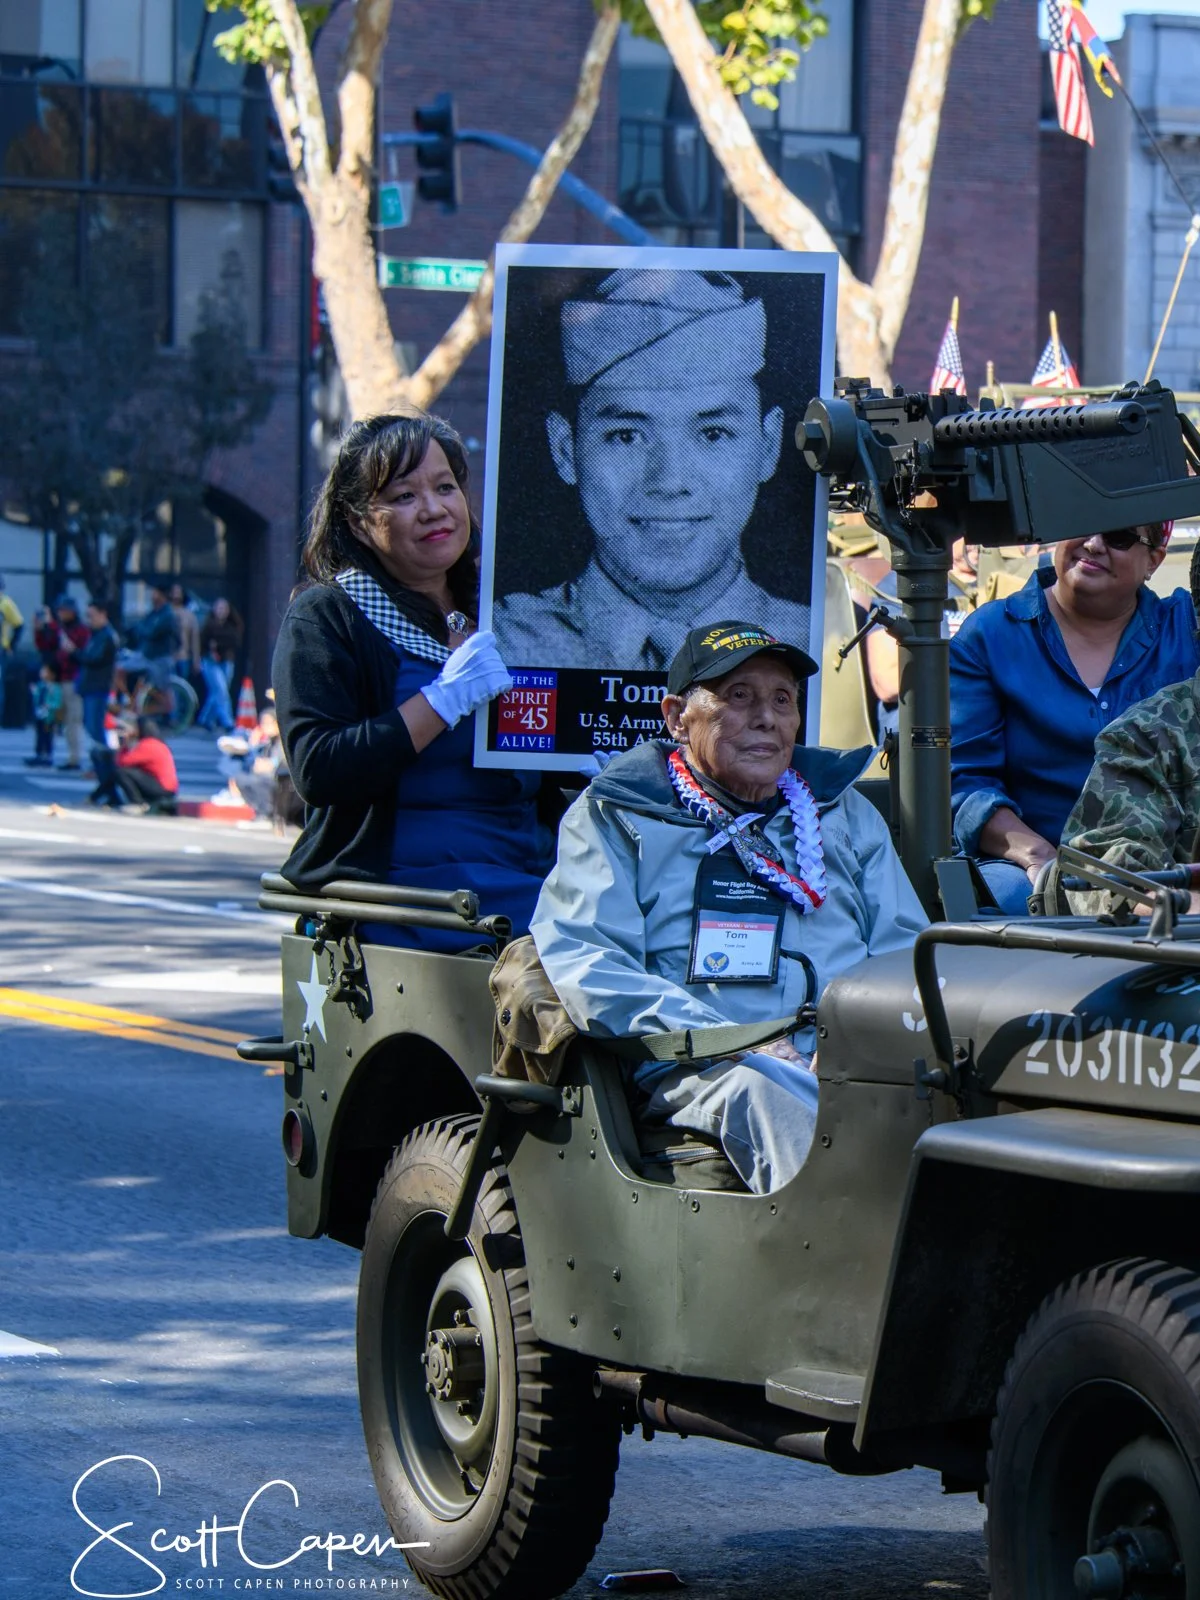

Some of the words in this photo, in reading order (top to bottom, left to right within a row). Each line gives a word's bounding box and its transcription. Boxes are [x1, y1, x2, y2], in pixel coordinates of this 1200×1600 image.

[512, 675, 529, 686] EEP
[533, 676, 554, 686] THE
[601, 677, 669, 703] Tom
[502, 692, 551, 706] SPIRIT
[503, 710, 517, 719] OF
[579, 713, 614, 728] U.S.
[620, 714, 665, 734] Army
[501, 736, 551, 748] ALIVE!
[592, 731, 628, 747] 55th
[712, 879, 730, 887] Honor
[730, 881, 746, 889] Flight
[746, 881, 757, 889] Bay
[724, 931, 748, 940] Tom
